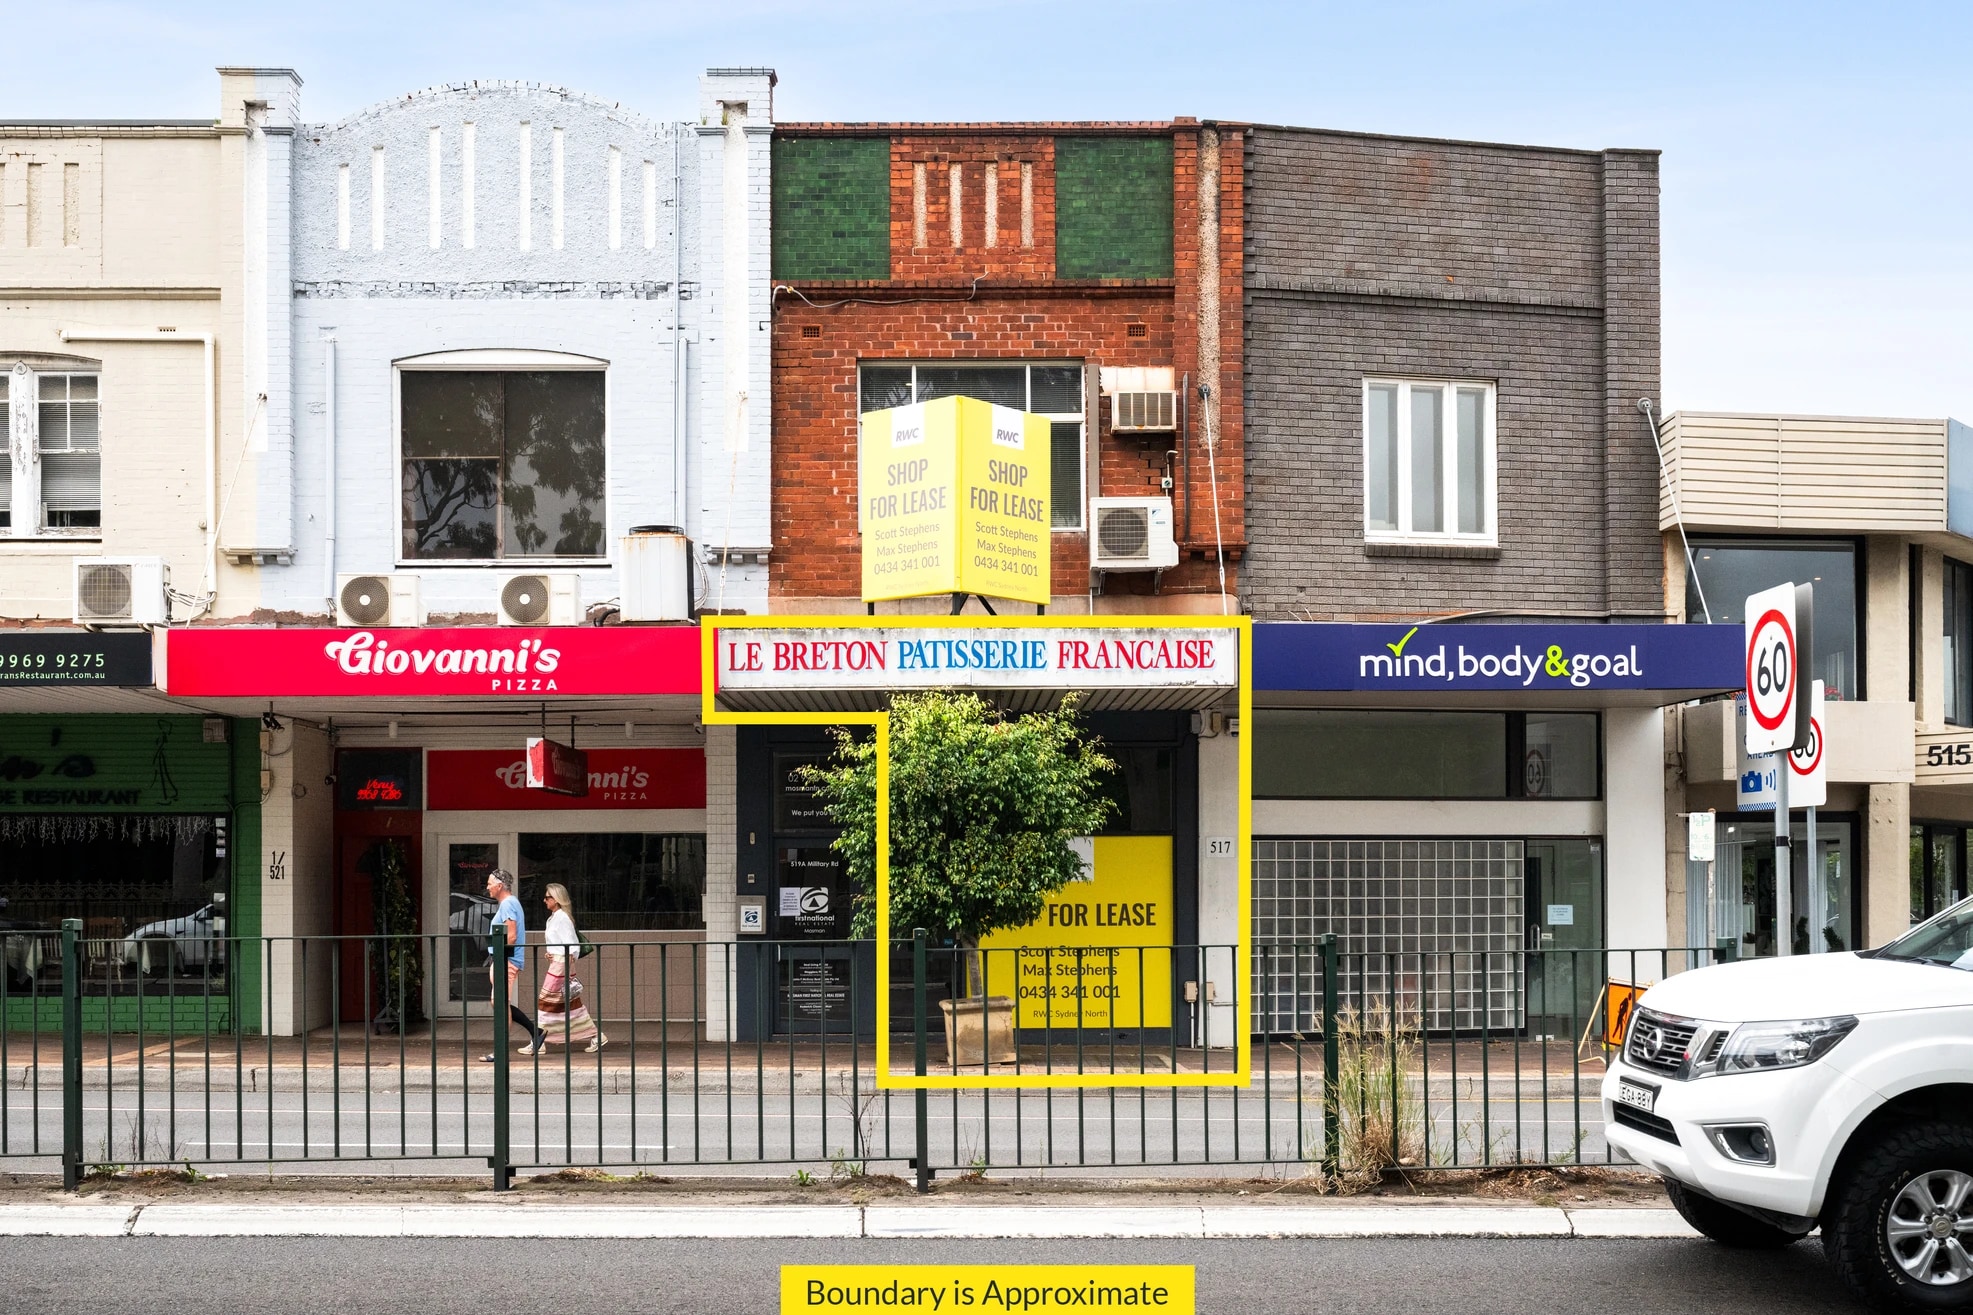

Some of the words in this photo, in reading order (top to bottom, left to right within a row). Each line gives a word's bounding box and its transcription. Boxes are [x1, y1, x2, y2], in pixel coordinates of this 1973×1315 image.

[896, 427, 919, 442] RWC
[996, 429, 1019, 443] RWC
[887, 458, 928, 486] SHOP
[988, 459, 1028, 487] SHOP
[870, 494, 897, 520] FOR
[902, 486, 946, 515] LEASE
[970, 486, 998, 514] FOR
[1003, 492, 1044, 522] LEASE
[875, 526, 897, 541] Scott
[899, 522, 940, 538] Stephens
[975, 521, 998, 535] Scott
[1000, 527, 1038, 543] Stephens
[876, 546, 896, 557] Max
[897, 539, 938, 555] Stephens
[977, 539, 996, 552] Max
[998, 542, 1037, 559] Stephens
[874, 561, 898, 575] 0434
[900, 559, 919, 571] 341
[921, 555, 940, 569] 001
[974, 555, 998, 570] 0434
[1001, 559, 1019, 573] 341
[1021, 563, 1038, 577] 001
[56, 653, 105, 667] 9275
[325, 631, 561, 675] Giovanni's
[728, 642, 763, 671] LE
[772, 640, 888, 672] BRETON
[897, 638, 1047, 670] PATISSERIE
[1057, 638, 1216, 670] FRANCAISE
[1757, 641, 1787, 696] 60
[491, 679, 558, 690] PIZZA
[1926, 744, 1972, 766] 515
[495, 761, 650, 789] Gnni's
[604, 792, 648, 800] PIZZA
[803, 809, 814, 817] put
[1210, 841, 1231, 854] 517
[271, 850, 285, 865] 1/
[270, 865, 285, 880] 521
[1048, 903, 1088, 927] FOR
[1096, 902, 1156, 926] LEASE
[1020, 945, 1055, 957] Scot
[1023, 963, 1052, 976] Max
[1056, 963, 1117, 979] Stephens
[1019, 985, 1057, 999] 0434
[1061, 985, 1089, 998] 341
[1092, 985, 1121, 998] 001
[1055, 1009, 1081, 1019] Sydne
[1085, 1009, 1108, 1018] North
